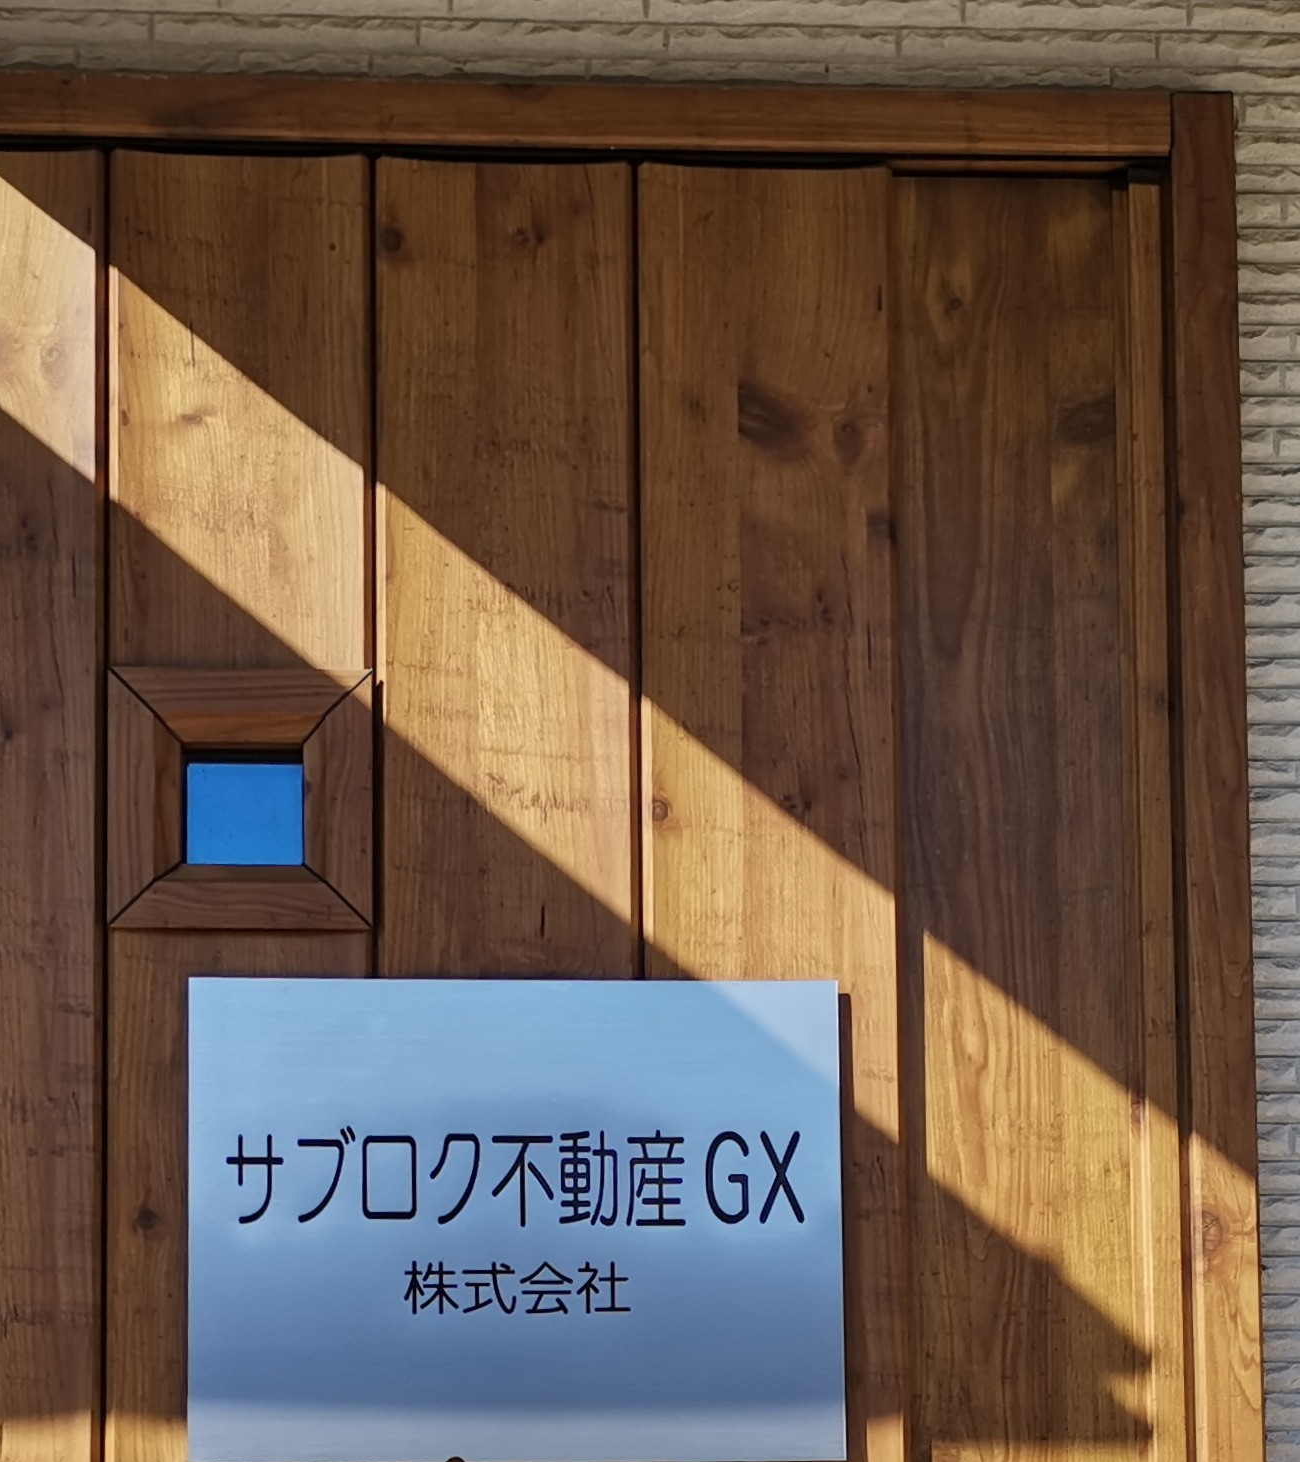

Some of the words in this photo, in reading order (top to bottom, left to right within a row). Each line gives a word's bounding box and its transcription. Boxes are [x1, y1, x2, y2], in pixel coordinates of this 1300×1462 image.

[225, 1125, 805, 1228] サブロク不動産GX
[403, 1260, 632, 1316] 株式会社
